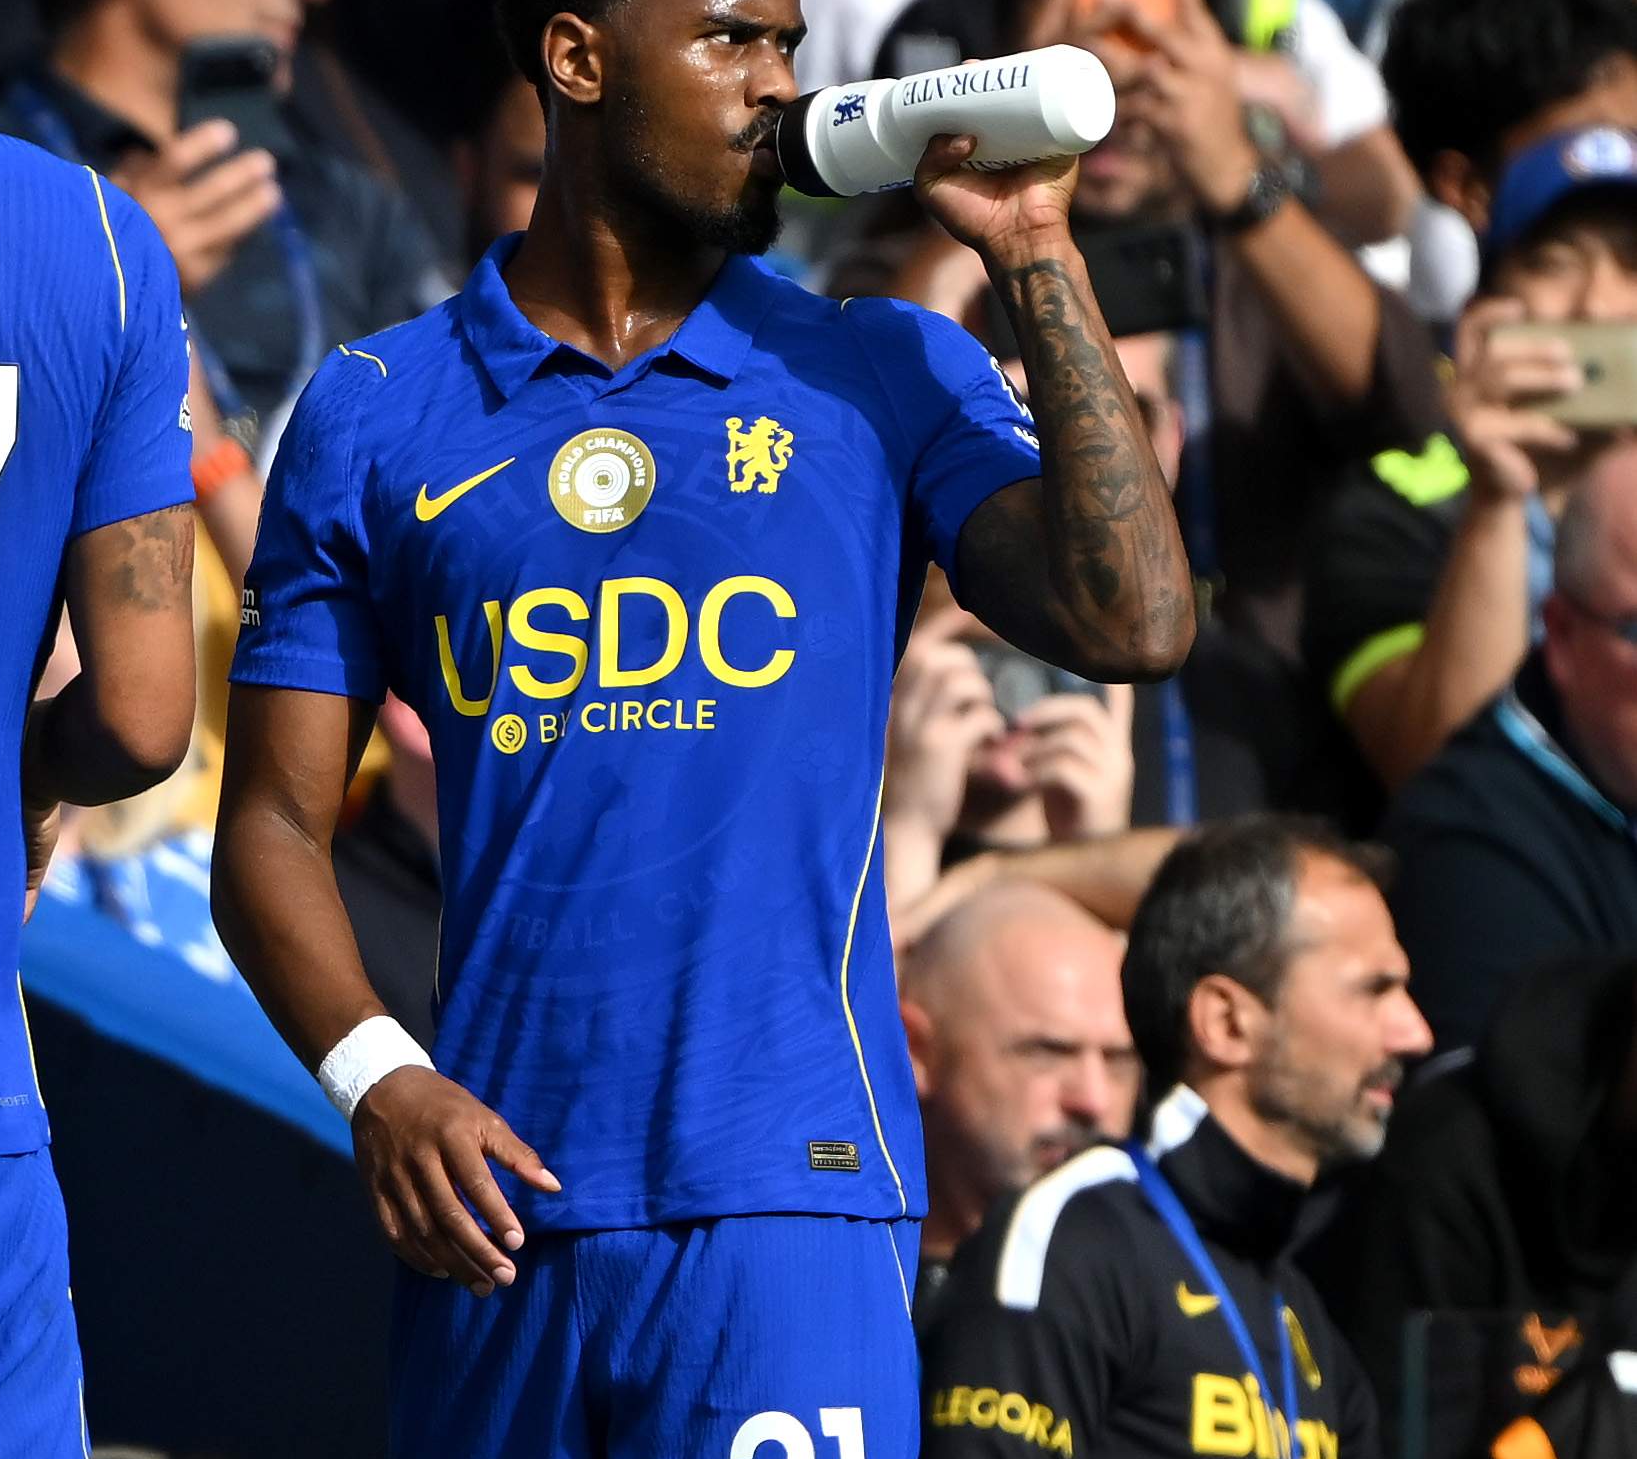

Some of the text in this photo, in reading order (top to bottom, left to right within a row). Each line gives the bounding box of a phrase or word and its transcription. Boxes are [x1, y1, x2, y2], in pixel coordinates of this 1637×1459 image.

[902, 64, 1030, 107] HYDRATE
[585, 436, 646, 487] CHAMPIONS
[583, 507, 625, 525] FIFA
[434, 574, 798, 718] USDC
[538, 699, 718, 744] BY CIRCLE
